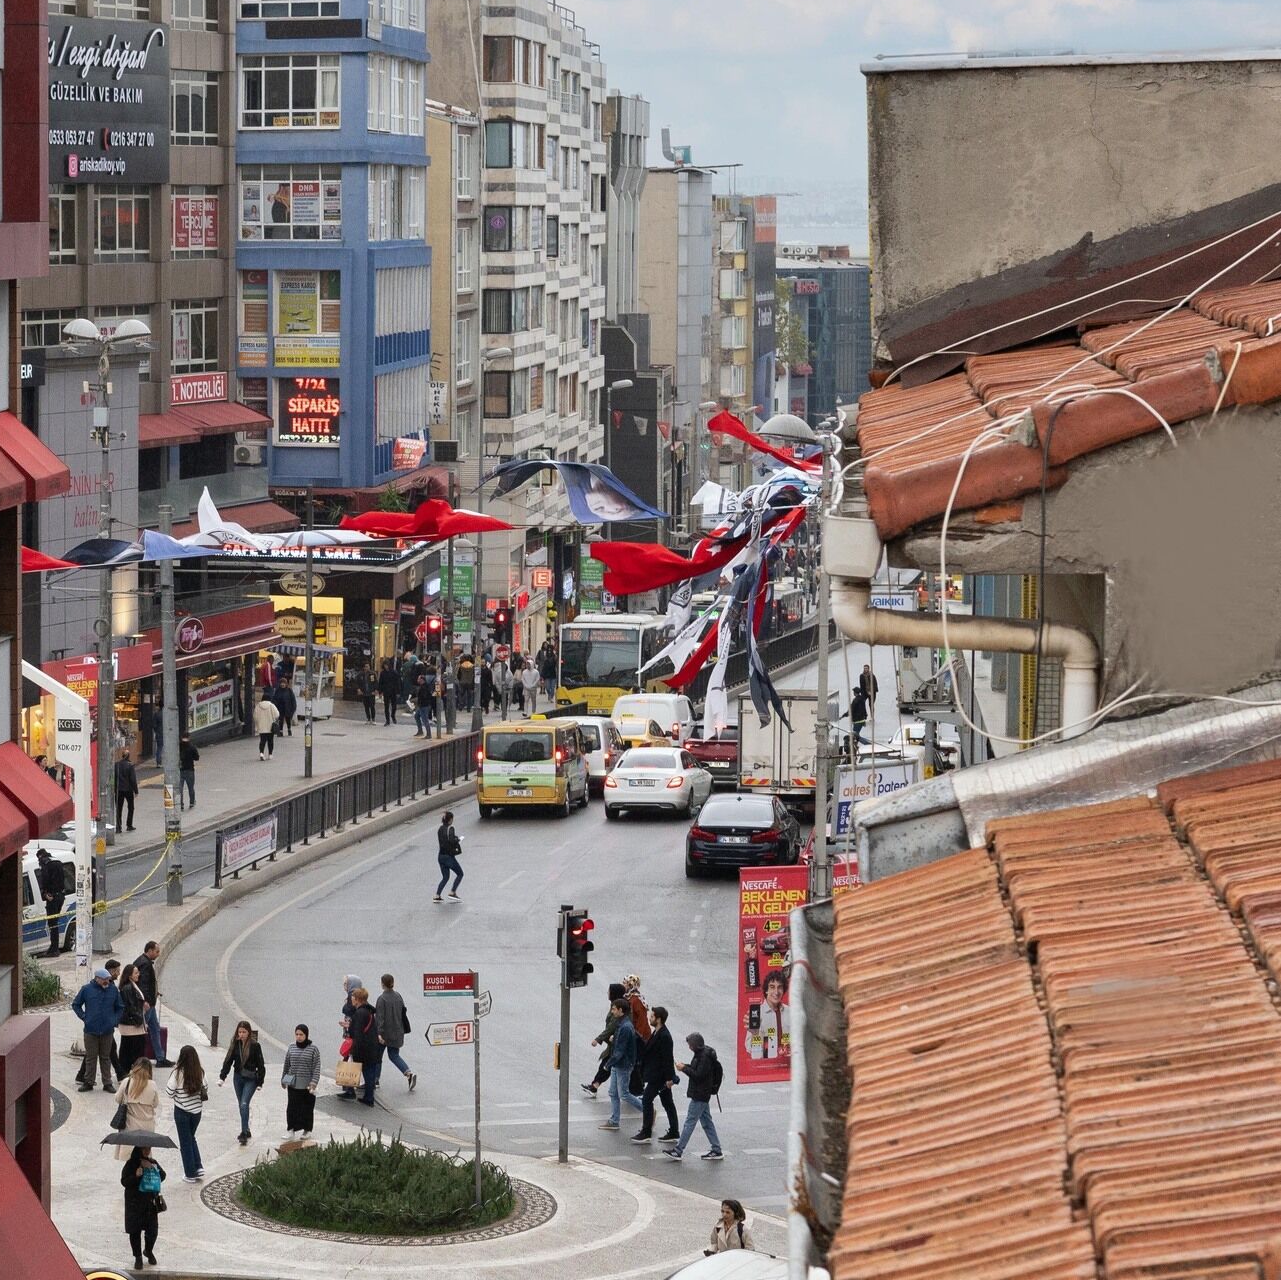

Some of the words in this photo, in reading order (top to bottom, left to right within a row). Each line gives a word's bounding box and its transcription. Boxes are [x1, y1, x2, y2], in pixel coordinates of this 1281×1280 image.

[69, 39, 102, 78] ezgi
[102, 28, 165, 80] doğan
[50, 81, 95, 102] GÜZELLİK
[98, 88, 110, 102] VE
[113, 87, 143, 104] BAKIM
[78, 131, 86, 146] 27
[110, 132, 126, 147] 0216
[126, 132, 138, 147] 347
[138, 133, 146, 147] 27
[180, 376, 224, 400] NOTERLİĞİ
[288, 394, 340, 417] SİPARİŞ
[292, 417, 330, 433] HATTI
[58, 720, 81, 729] KGYS
[57, 744, 81, 752] KDK-077
[742, 877, 778, 890] NESCAFÉ
[741, 889, 807, 903] BEKLENEN
[741, 903, 760, 914] AN
[426, 975, 454, 986] KUŞDİLİ
